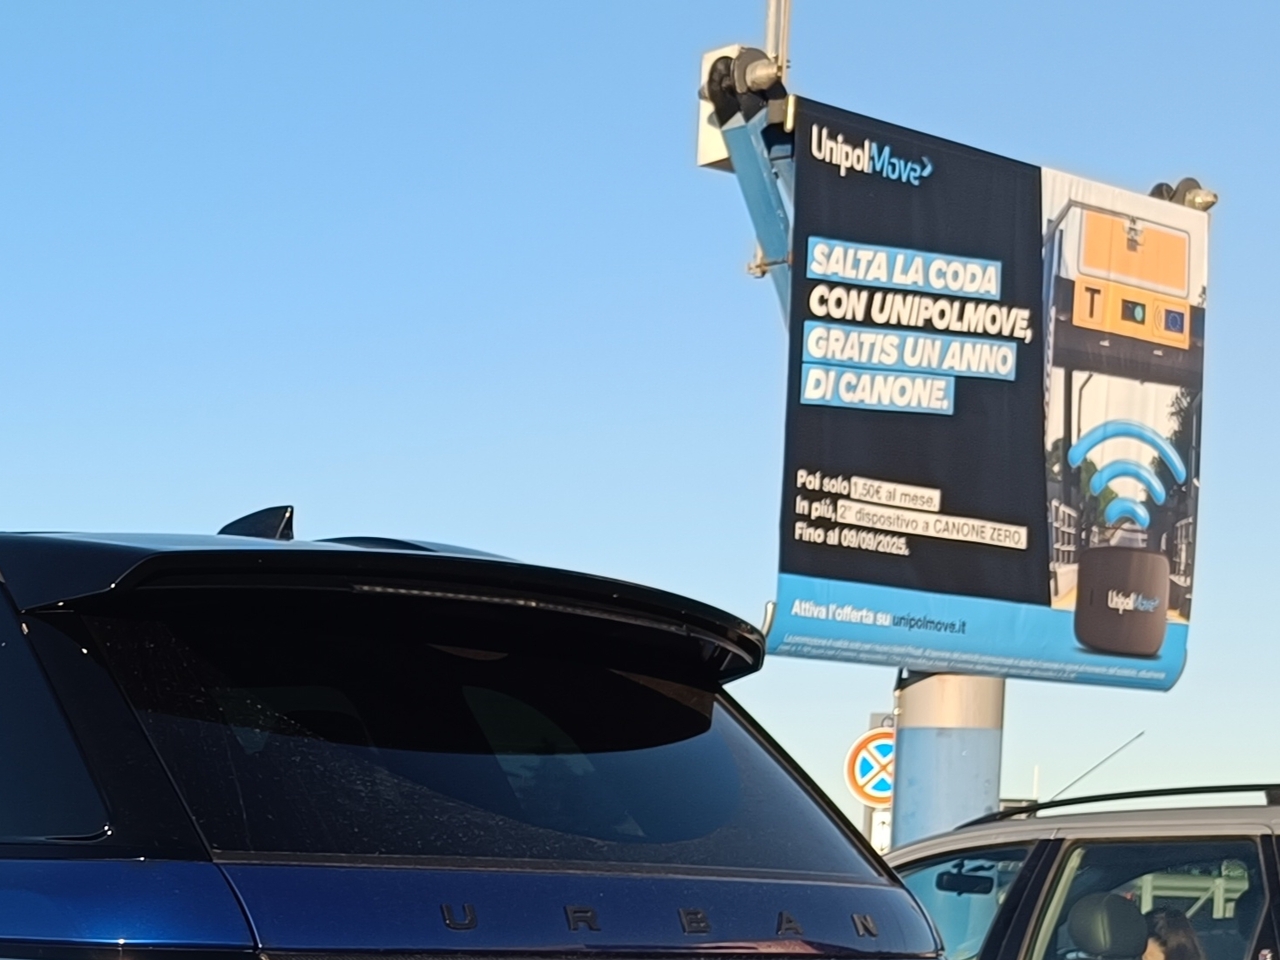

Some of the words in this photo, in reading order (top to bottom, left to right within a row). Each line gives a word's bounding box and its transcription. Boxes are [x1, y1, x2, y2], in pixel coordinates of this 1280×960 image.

[811, 123, 921, 186] UnipolMove
[810, 243, 888, 283] SALTA
[893, 255, 925, 286] LA
[928, 258, 998, 295] CODA
[809, 285, 867, 321] CON
[871, 289, 1033, 344] UNIPOLMOVE,
[1085, 286, 1101, 319] T
[806, 328, 899, 366] GRATIS
[903, 338, 944, 370] UN
[944, 341, 1013, 375] ANNO
[804, 370, 833, 400] DI
[838, 373, 949, 410] CANONE.
[797, 469, 821, 491] Poi
[822, 474, 849, 496] solo
[852, 481, 882, 500] 1,50€
[885, 486, 896, 501] al
[900, 492, 937, 510] mese.
[794, 522, 824, 543] Fino
[826, 527, 839, 545] al
[841, 528, 910, 556] 09/09/2025.
[795, 495, 809, 515] In
[811, 498, 836, 522] più,
[855, 509, 919, 534] dispositivo
[922, 521, 930, 532] a
[933, 518, 986, 540] CANONE
[989, 527, 1024, 546] ZERO.
[792, 599, 826, 620] Attiva
[828, 603, 874, 625] l'offerta
[876, 613, 890, 626] su
[892, 613, 967, 635] unipolmove.it
[441, 903, 879, 938] URBAN
